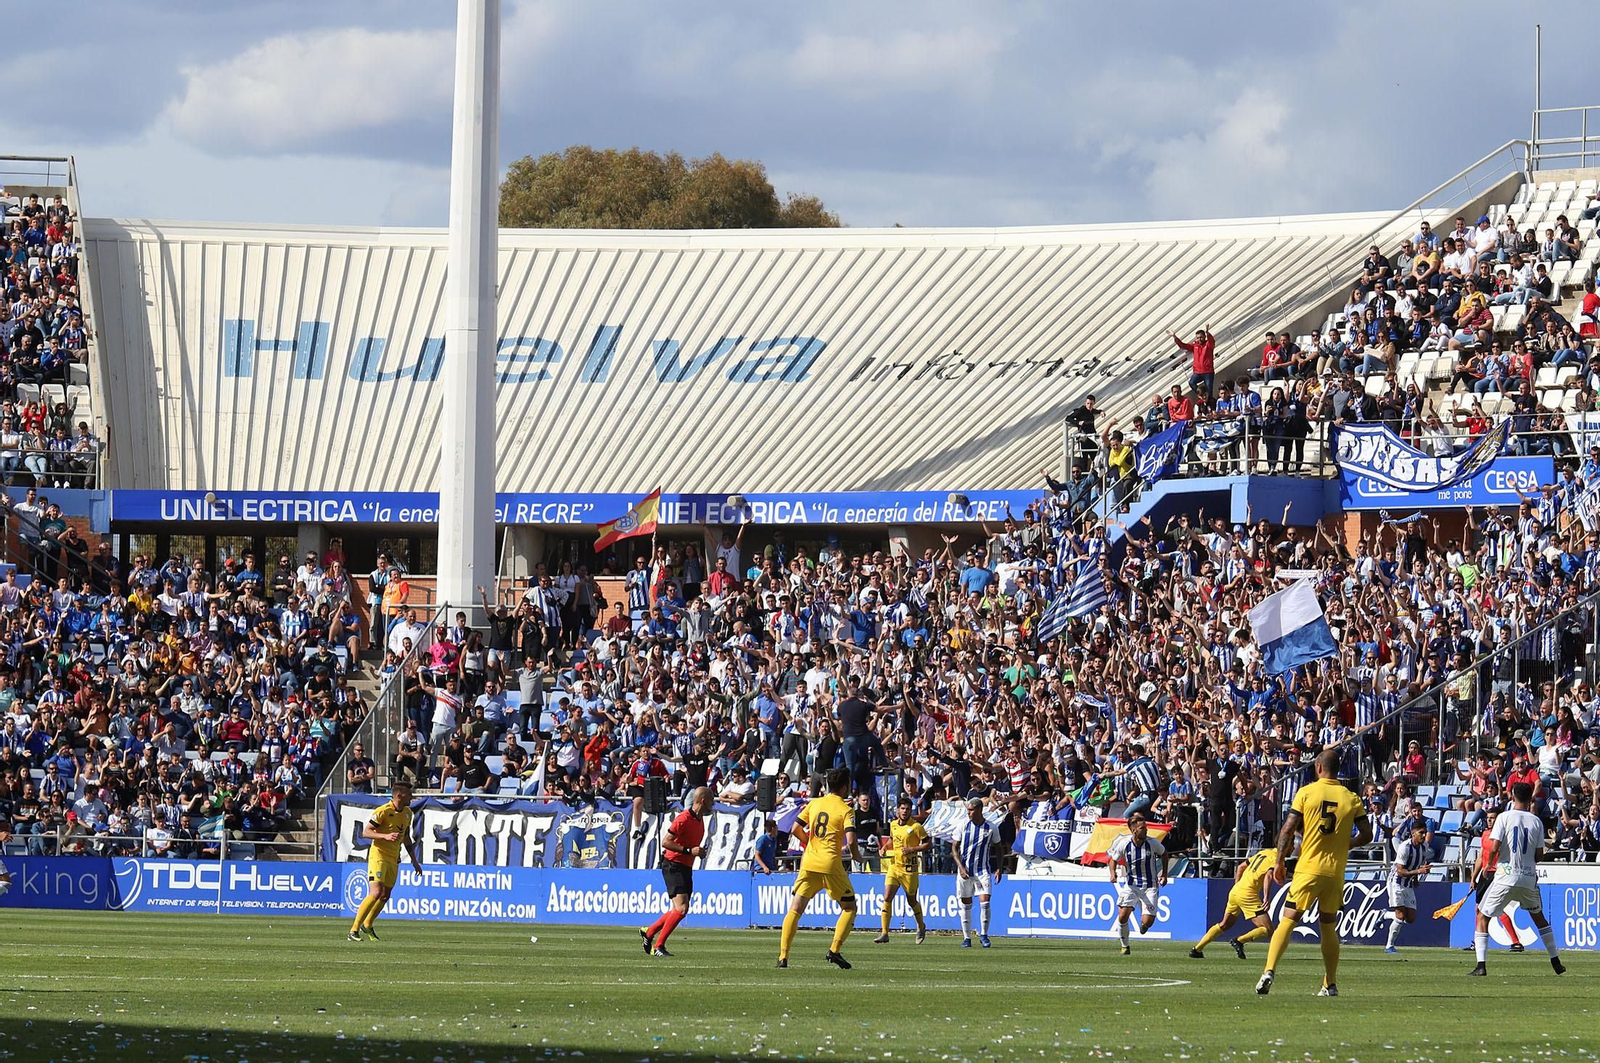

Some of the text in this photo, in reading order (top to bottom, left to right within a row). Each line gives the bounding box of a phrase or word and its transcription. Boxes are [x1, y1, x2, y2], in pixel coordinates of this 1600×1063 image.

[224, 319, 827, 383] Huelva
[1484, 470, 1538, 492] CEOSA
[1438, 490, 1473, 502] me pone
[161, 498, 358, 522] UNIELECTRICA
[398, 507, 440, 522] ener
[495, 503, 508, 522] el
[844, 501, 907, 523] energía
[913, 501, 938, 522] del
[815, 811, 829, 838] 8
[1318, 800, 1338, 835] 5
[1511, 826, 1528, 854] 11
[1249, 853, 1267, 873] 11
[143, 862, 220, 890] TDC
[400, 869, 511, 890] HOTEL MARTÍN
[147, 898, 184, 906] INTERNET
[185, 899, 196, 907] DE
[197, 899, 218, 908] FIBRA
[380, 897, 536, 919] ALONSO PINZÓN.COM
